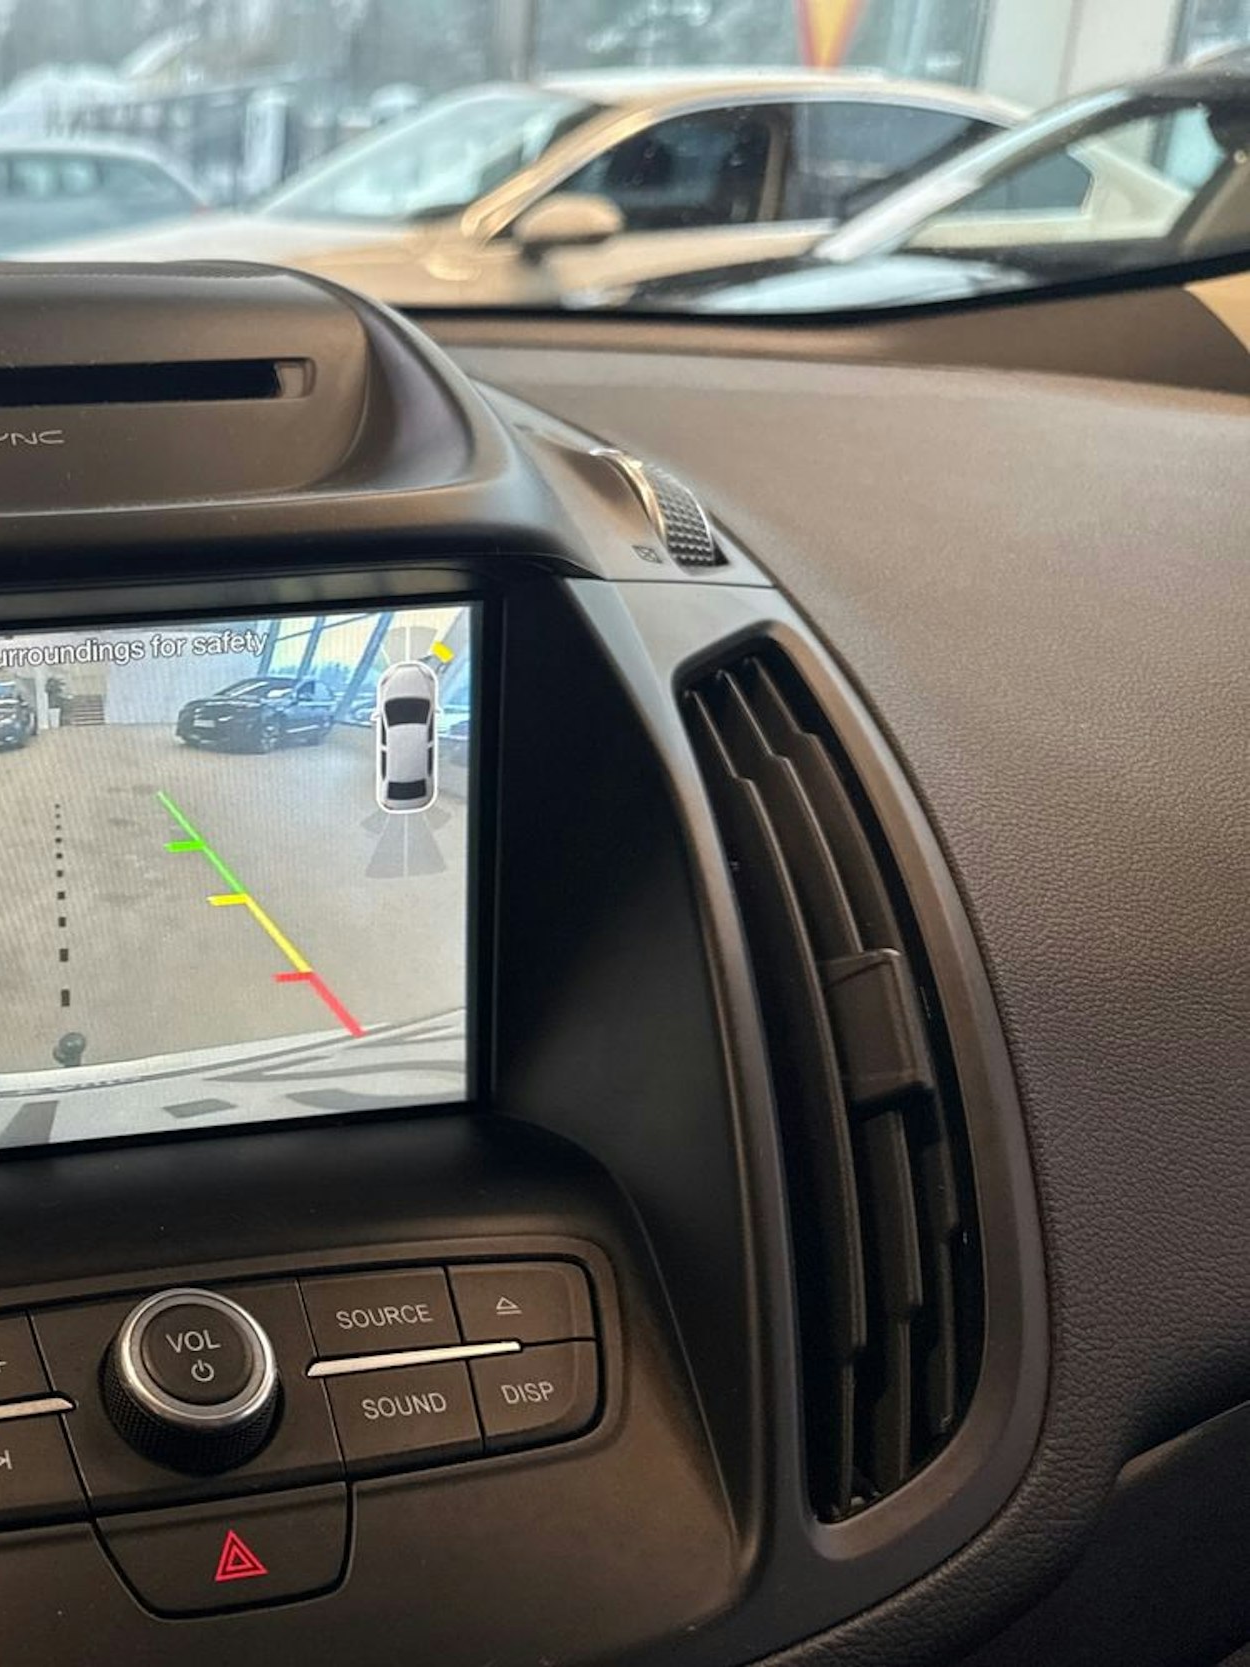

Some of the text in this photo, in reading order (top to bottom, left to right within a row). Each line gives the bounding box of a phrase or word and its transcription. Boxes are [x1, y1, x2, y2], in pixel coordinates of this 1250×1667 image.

[150, 633, 187, 658] for
[192, 629, 268, 658] safety
[336, 1304, 433, 1330] SOURCE
[165, 1329, 221, 1353] VOL
[361, 1392, 447, 1419] SOUND
[501, 1381, 554, 1404] DISP
